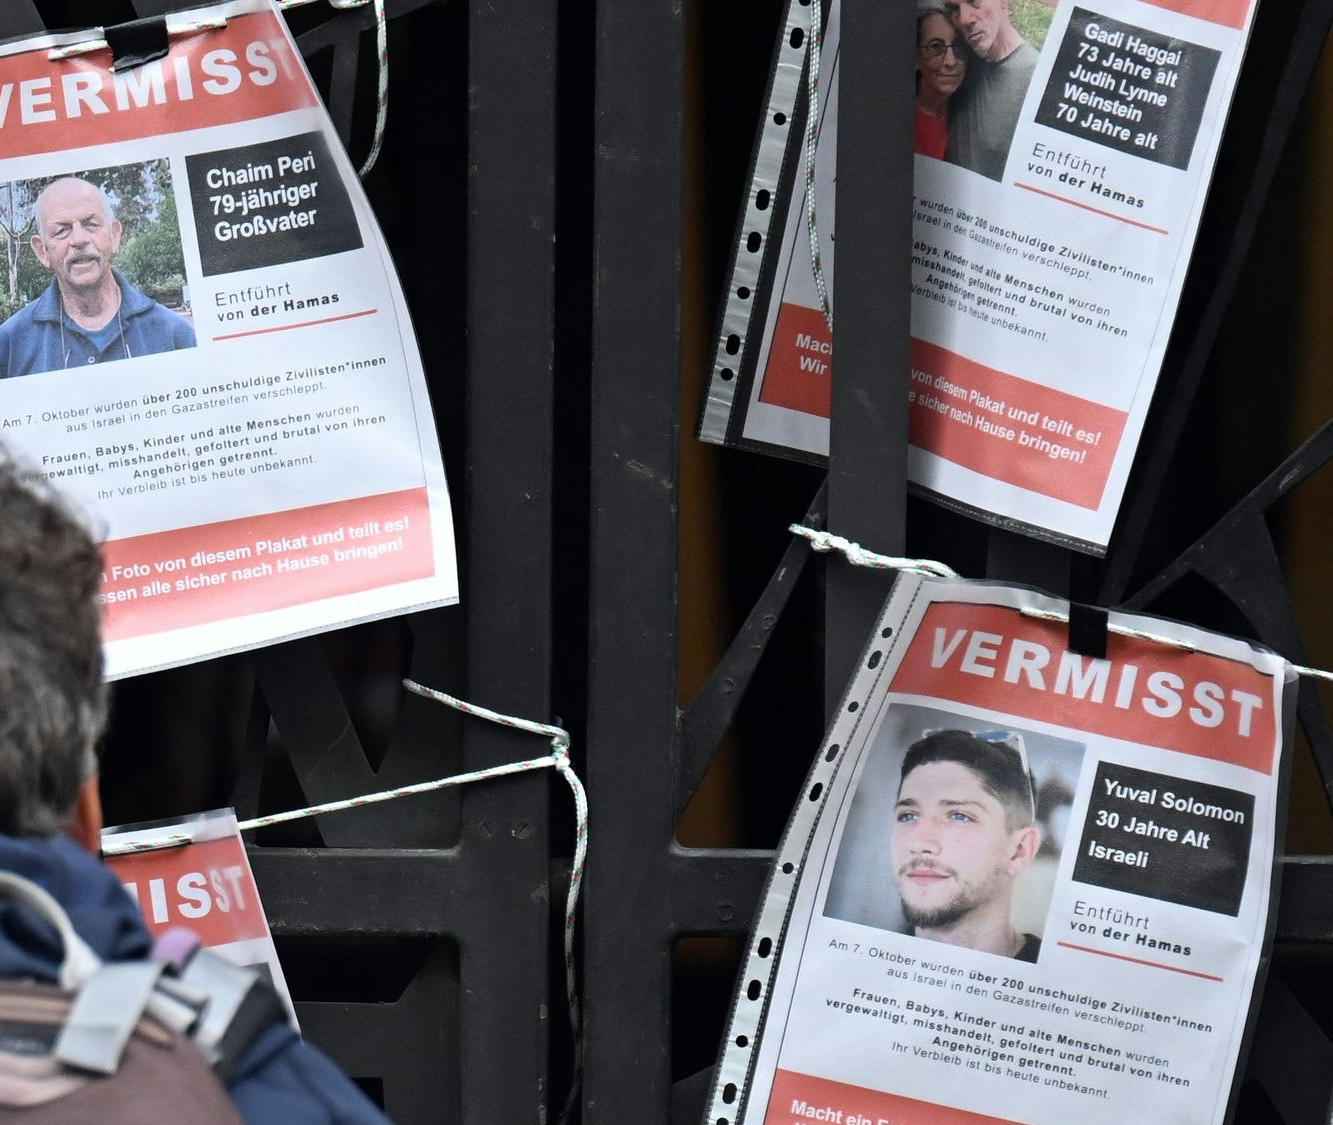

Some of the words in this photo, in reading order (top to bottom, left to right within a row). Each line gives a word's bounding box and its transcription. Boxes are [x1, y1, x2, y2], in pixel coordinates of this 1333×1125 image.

[1077, 41, 1100, 63] 73
[1101, 51, 1152, 80] Jahre
[1154, 67, 1179, 89] alt
[1083, 22, 1125, 49] Gadi
[1124, 34, 1182, 66] Haggai
[1063, 81, 1143, 123] Weinstein
[1068, 63, 1116, 91] Judih
[1117, 78, 1168, 108] Lynne
[1055, 101, 1078, 123] 70
[1079, 112, 1131, 141] Jahre
[1133, 131, 1159, 150] alt
[205, 162, 274, 189] Chaim
[276, 150, 316, 177] Peri
[1031, 141, 1107, 179] Entführt
[208, 181, 318, 216] 79-jähriger
[1027, 162, 1053, 178] von
[1057, 171, 1086, 188] der
[1089, 180, 1145, 209] Hamas
[213, 208, 317, 242] Großvater
[931, 626, 1264, 739] VERMISST
[1104, 777, 1158, 805] Yuval
[1160, 791, 1245, 825] Solomon
[1095, 809, 1120, 829] 30
[1122, 816, 1179, 842] Jahre
[1180, 828, 1211, 850] Alt
[1087, 839, 1149, 868] Israeli
[891, 1041, 909, 1053] Ihr
[912, 1045, 962, 1066] Verbleib
[965, 1059, 981, 1070] ist
[983, 1061, 1002, 1075] bis
[1005, 1066, 1040, 1084] heute
[1043, 1077, 1111, 1100] unbekannt.
